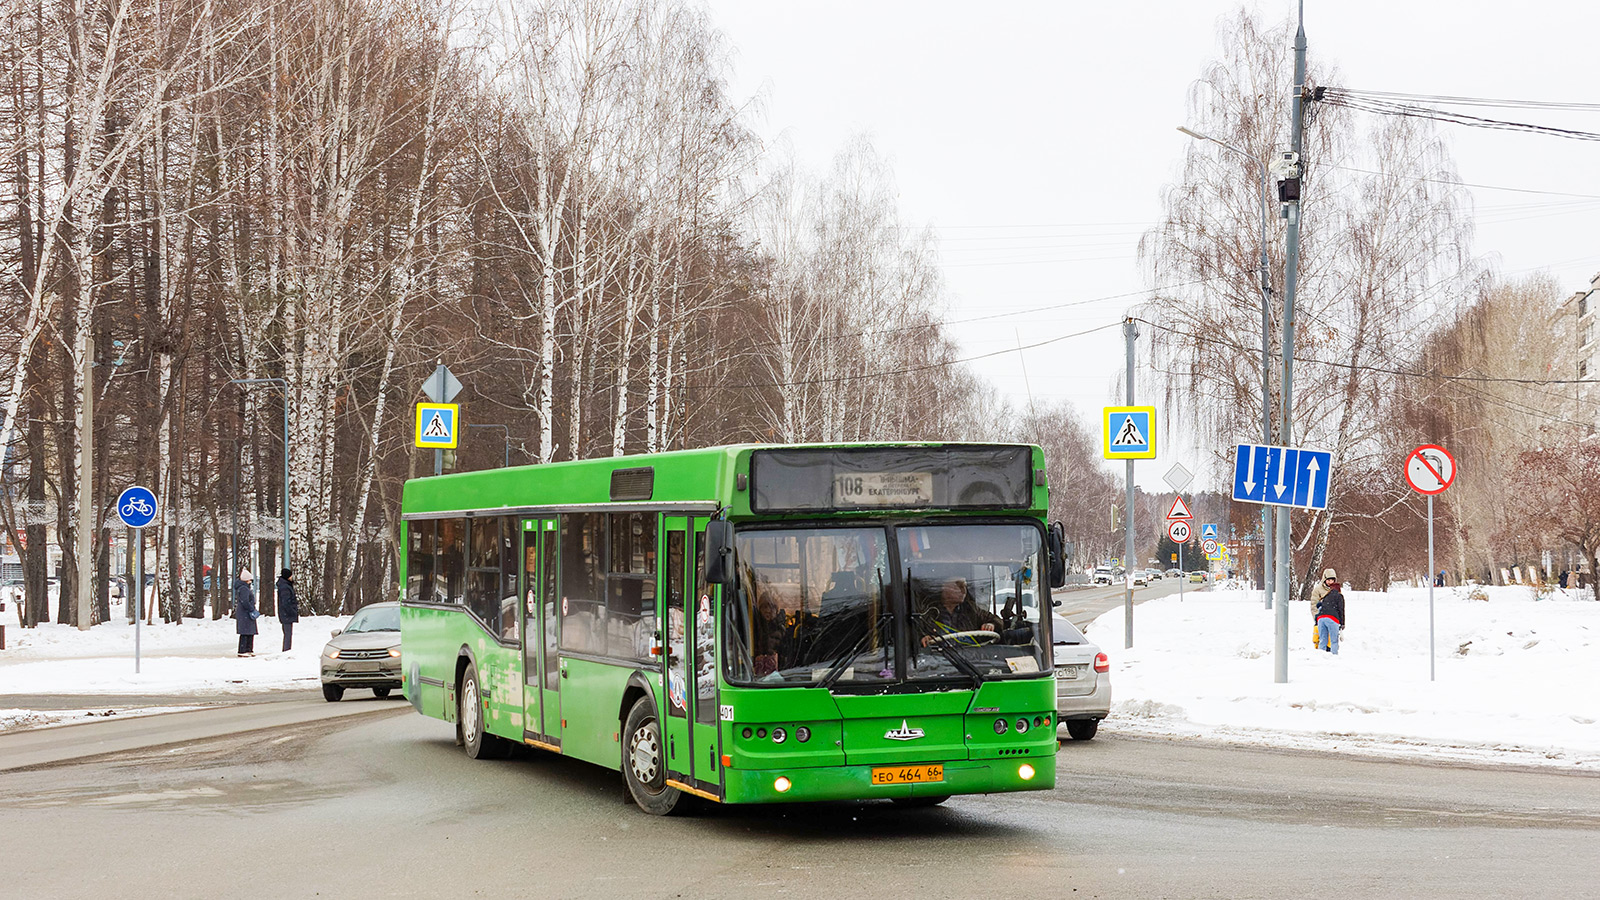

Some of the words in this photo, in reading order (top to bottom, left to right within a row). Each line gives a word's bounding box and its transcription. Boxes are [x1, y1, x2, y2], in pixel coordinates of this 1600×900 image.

[840, 477, 863, 496] 108
[869, 488, 920, 496] ЕКАТЕРИНБУРГ
[1173, 527, 1187, 536] 40
[1205, 543, 1215, 551] 20
[720, 707, 733, 719] 401
[878, 772, 894, 782] ЕО
[899, 768, 921, 781] 464
[927, 767, 939, 776] 66
